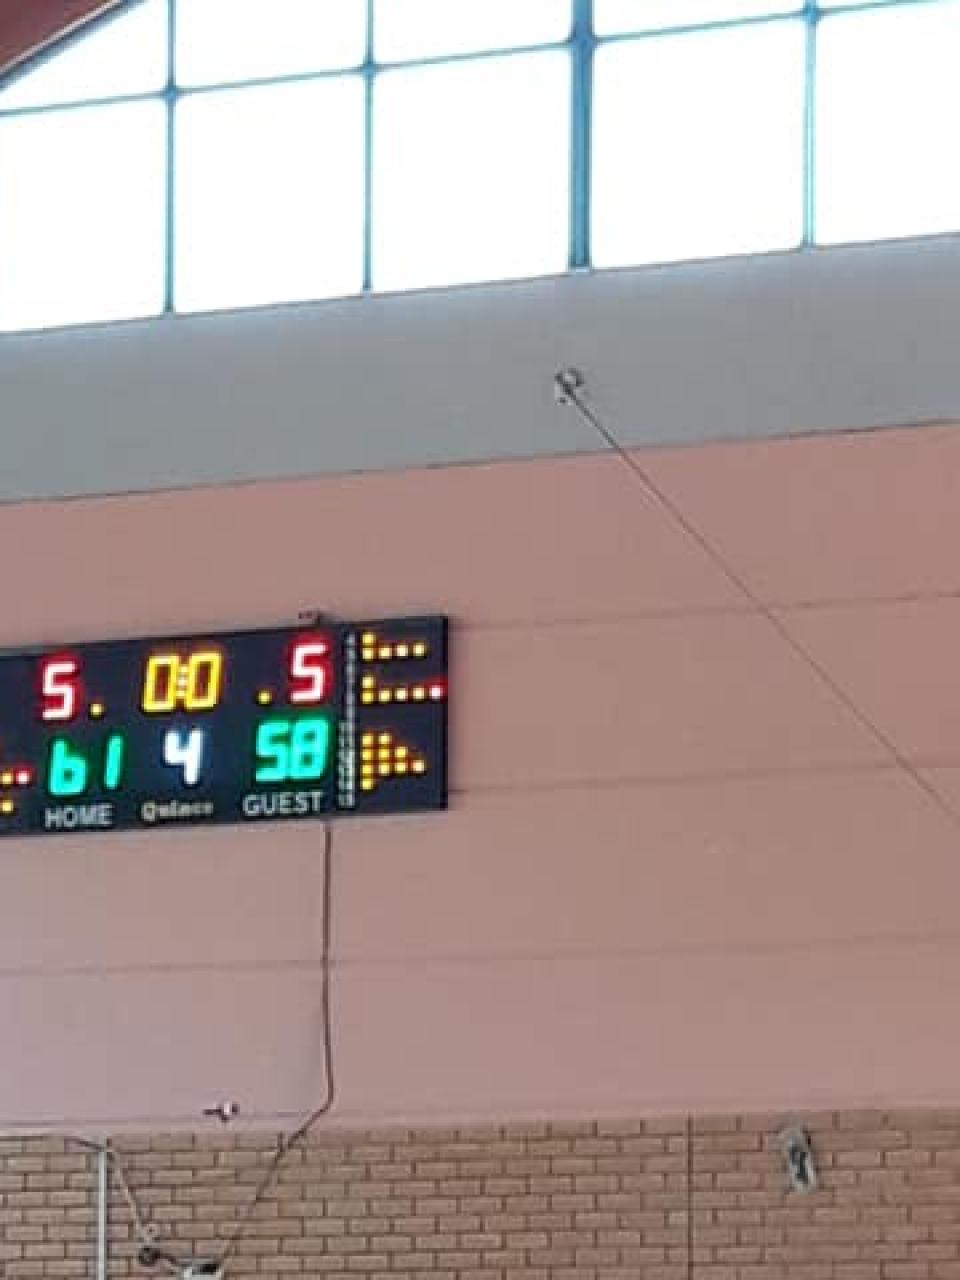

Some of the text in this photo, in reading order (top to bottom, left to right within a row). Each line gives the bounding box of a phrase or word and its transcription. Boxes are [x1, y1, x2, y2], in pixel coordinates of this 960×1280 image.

[50, 735, 124, 796] 61
[163, 729, 202, 786] 4
[255, 719, 329, 782] 58
[44, 803, 113, 828] HOME
[242, 790, 322, 816] GUEST
